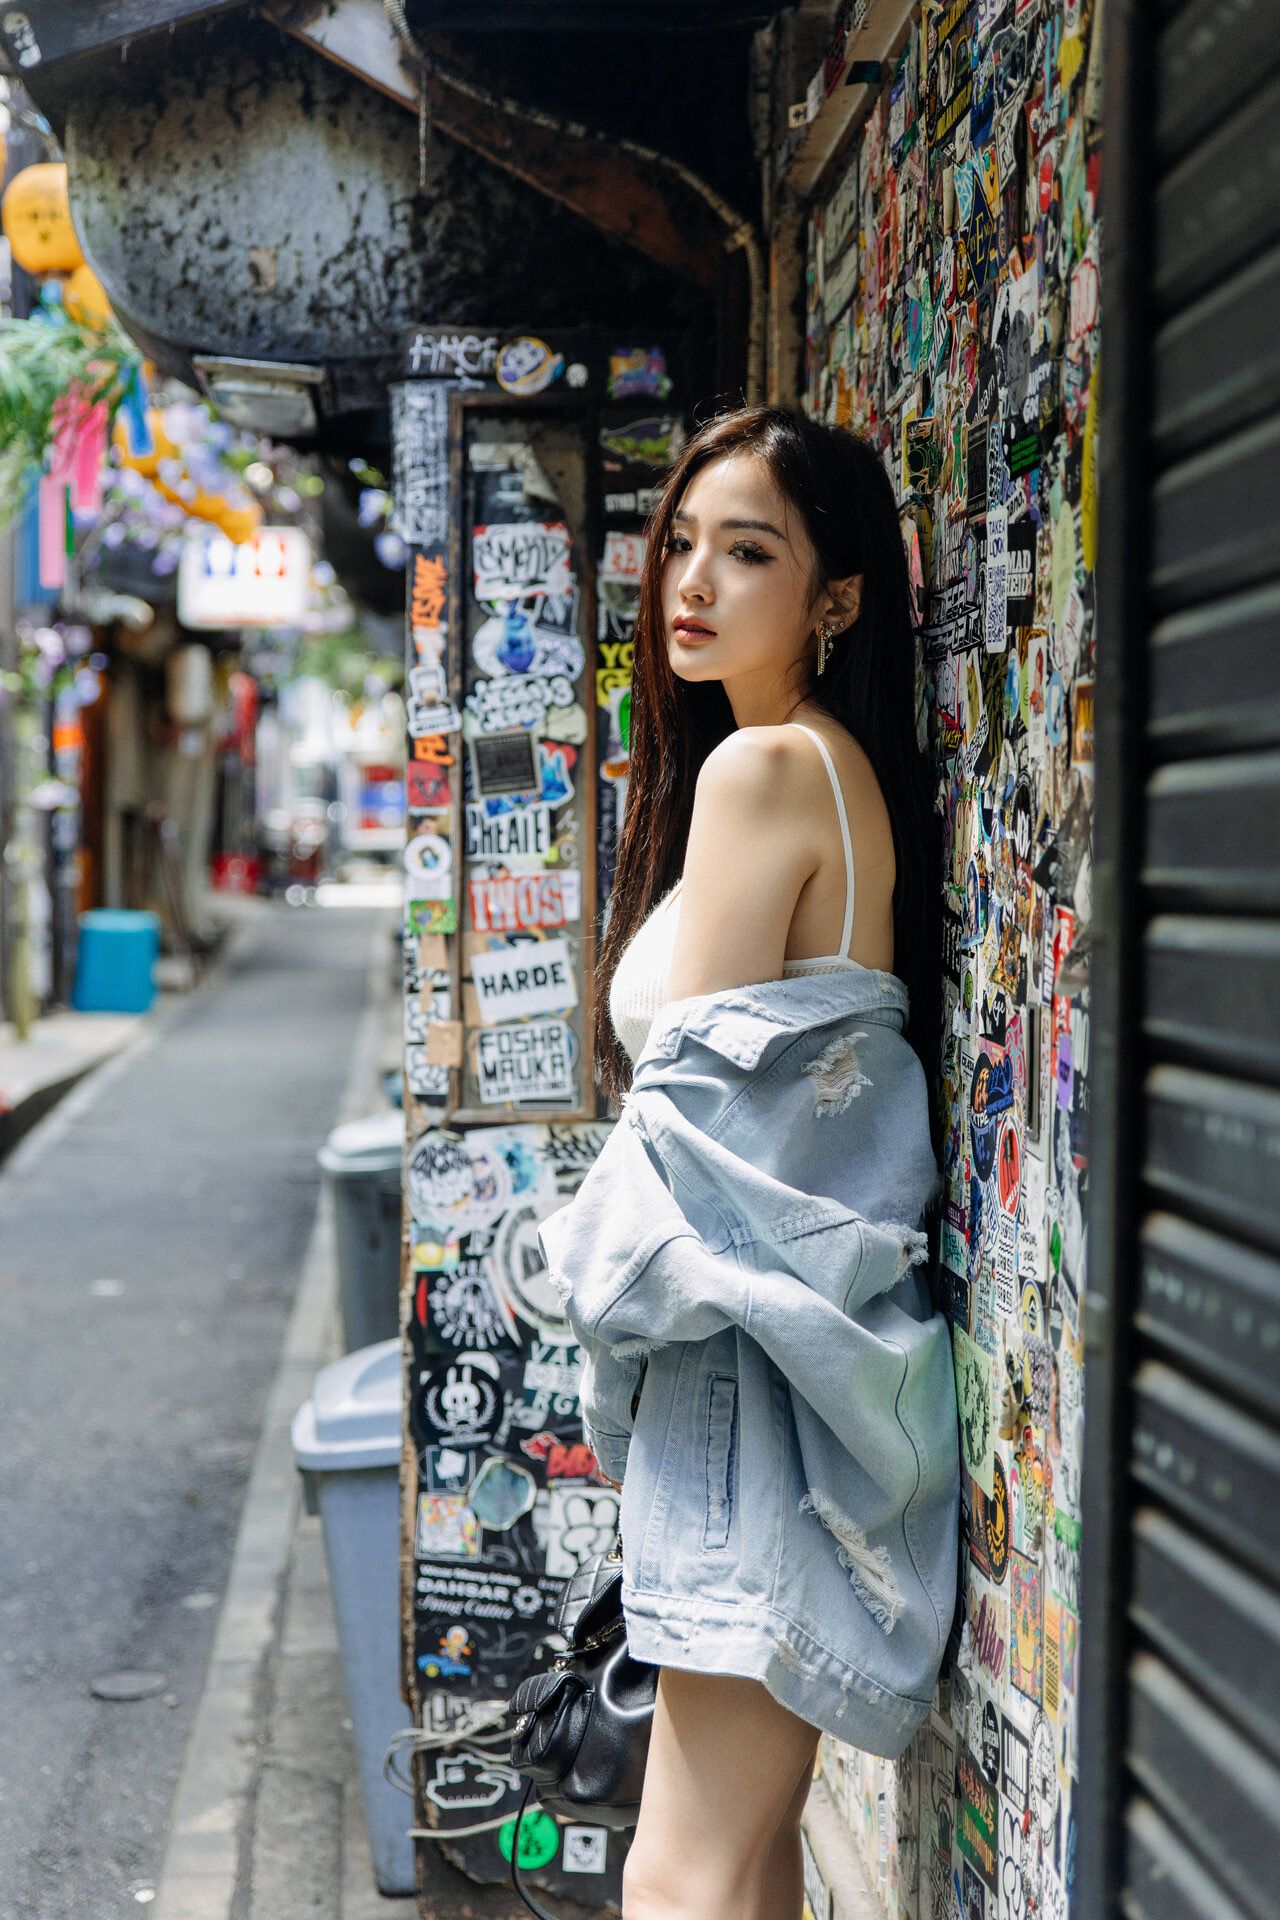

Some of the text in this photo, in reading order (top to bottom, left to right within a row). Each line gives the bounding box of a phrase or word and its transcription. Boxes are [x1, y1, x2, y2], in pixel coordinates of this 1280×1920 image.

[989, 519, 1002, 535] TAKE
[990, 537, 1005, 558] LOOK
[468, 807, 543, 856] CREATE
[481, 961, 567, 998] HARDE
